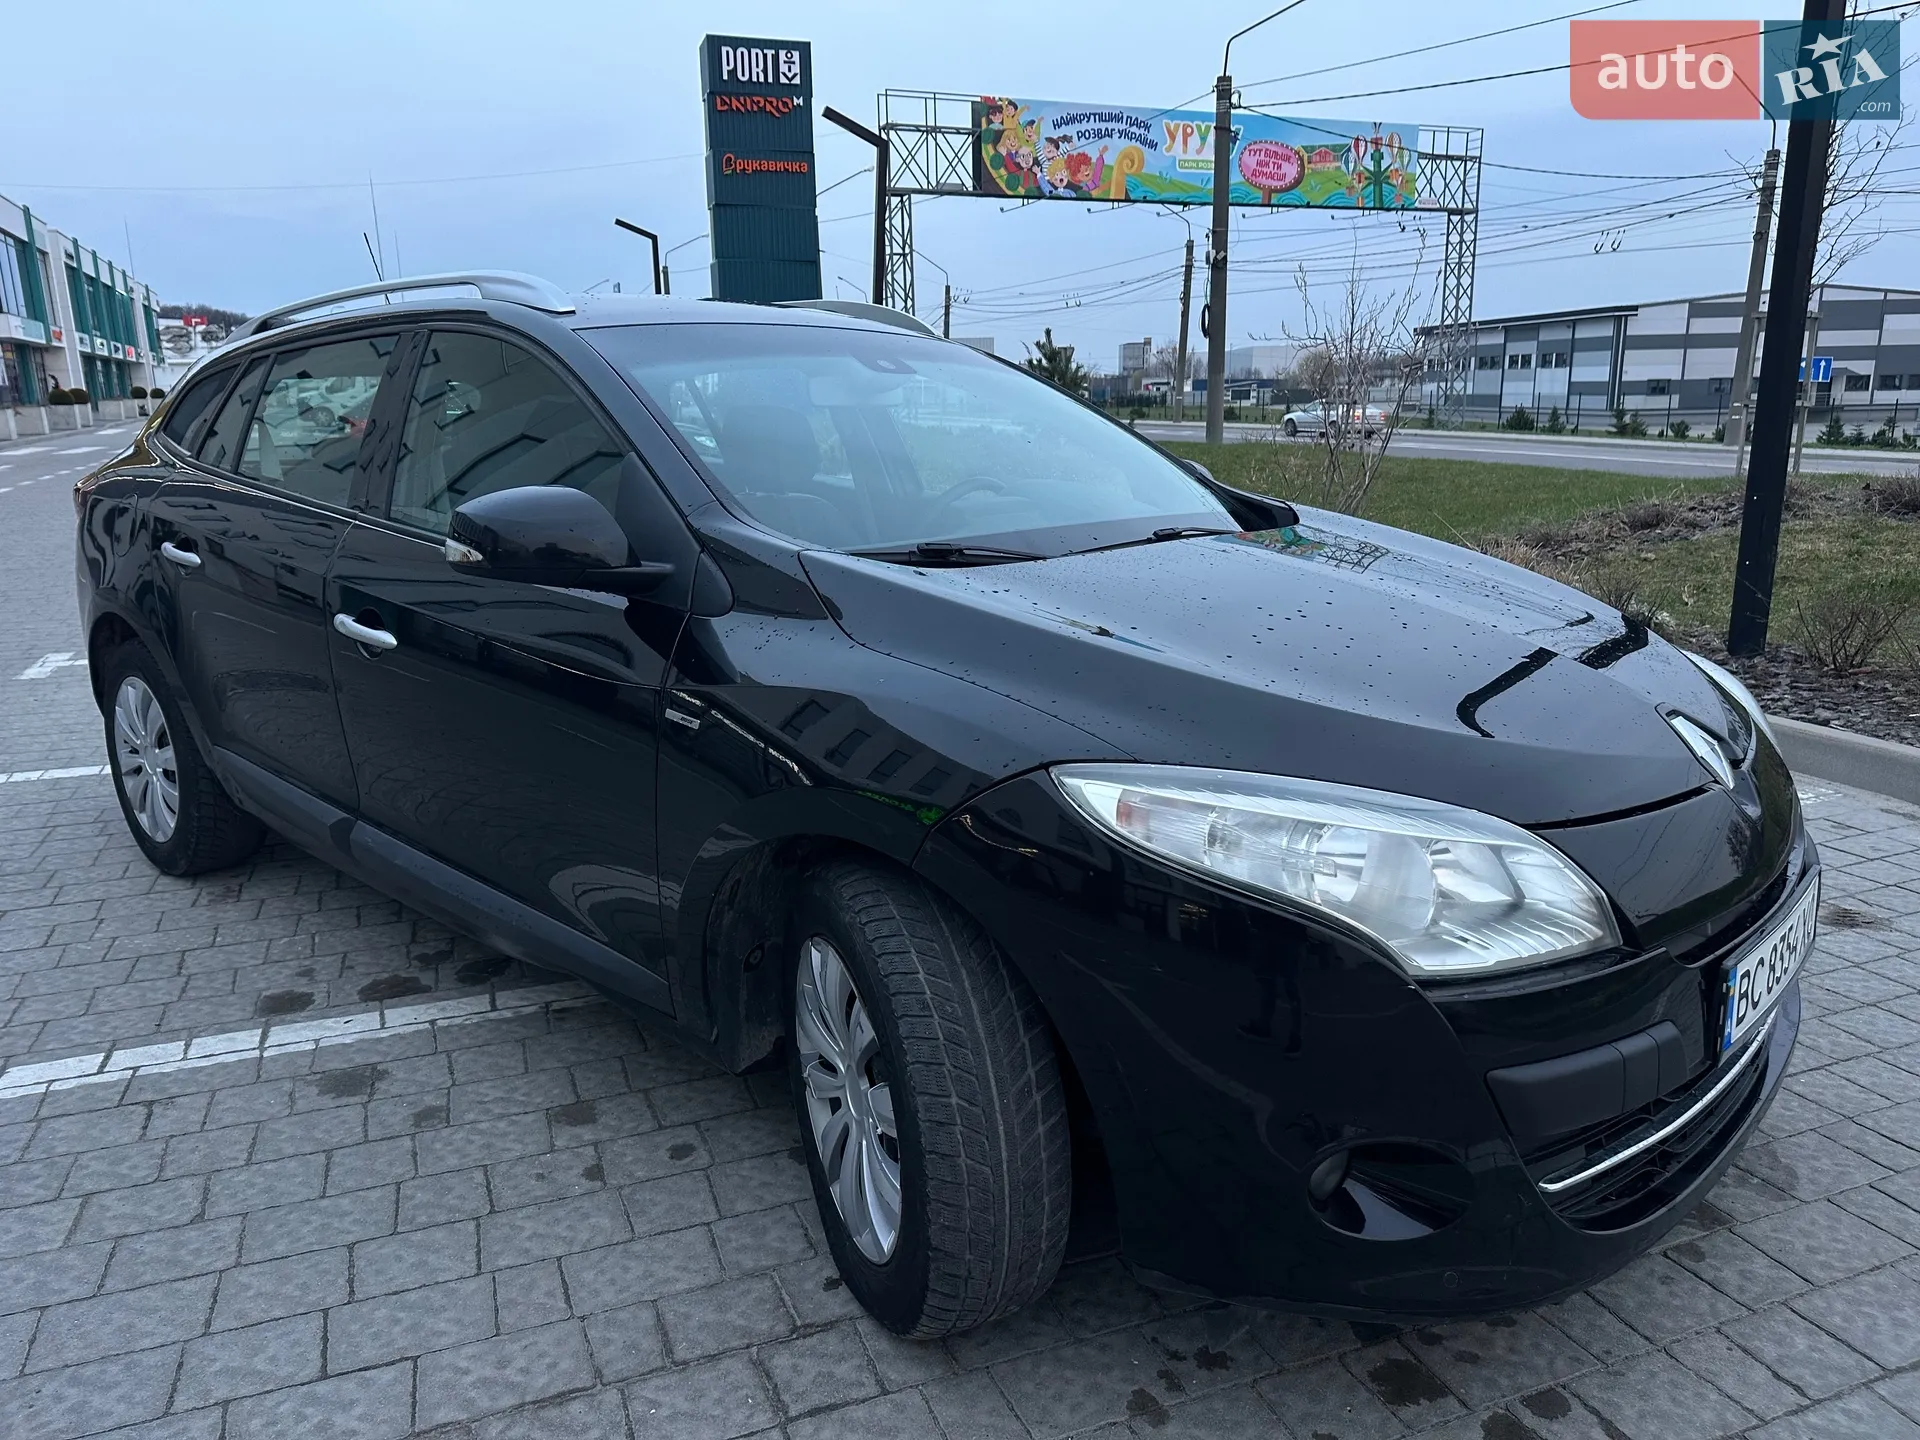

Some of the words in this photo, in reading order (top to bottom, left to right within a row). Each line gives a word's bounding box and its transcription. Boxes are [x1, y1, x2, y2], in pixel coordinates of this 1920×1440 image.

[721, 46, 775, 84] PORT
[716, 95, 793, 118] DNIPRO
[1052, 110, 1124, 130] НАЙКРУТІШИЙ
[1125, 115, 1152, 134] ПАРК
[1076, 127, 1116, 141] РОЗВАГ
[1117, 128, 1159, 151] УКРАЇНИ
[1248, 148, 1263, 157] ТУТ
[1264, 148, 1294, 166] БІЛЬШЕ,
[1256, 159, 1270, 169] НІЖ
[1272, 161, 1283, 171] ТИ
[1251, 168, 1287, 182] ДУМАЄШ!
[1736, 956, 1764, 1028] BC
[1766, 914, 1800, 995] 8354
